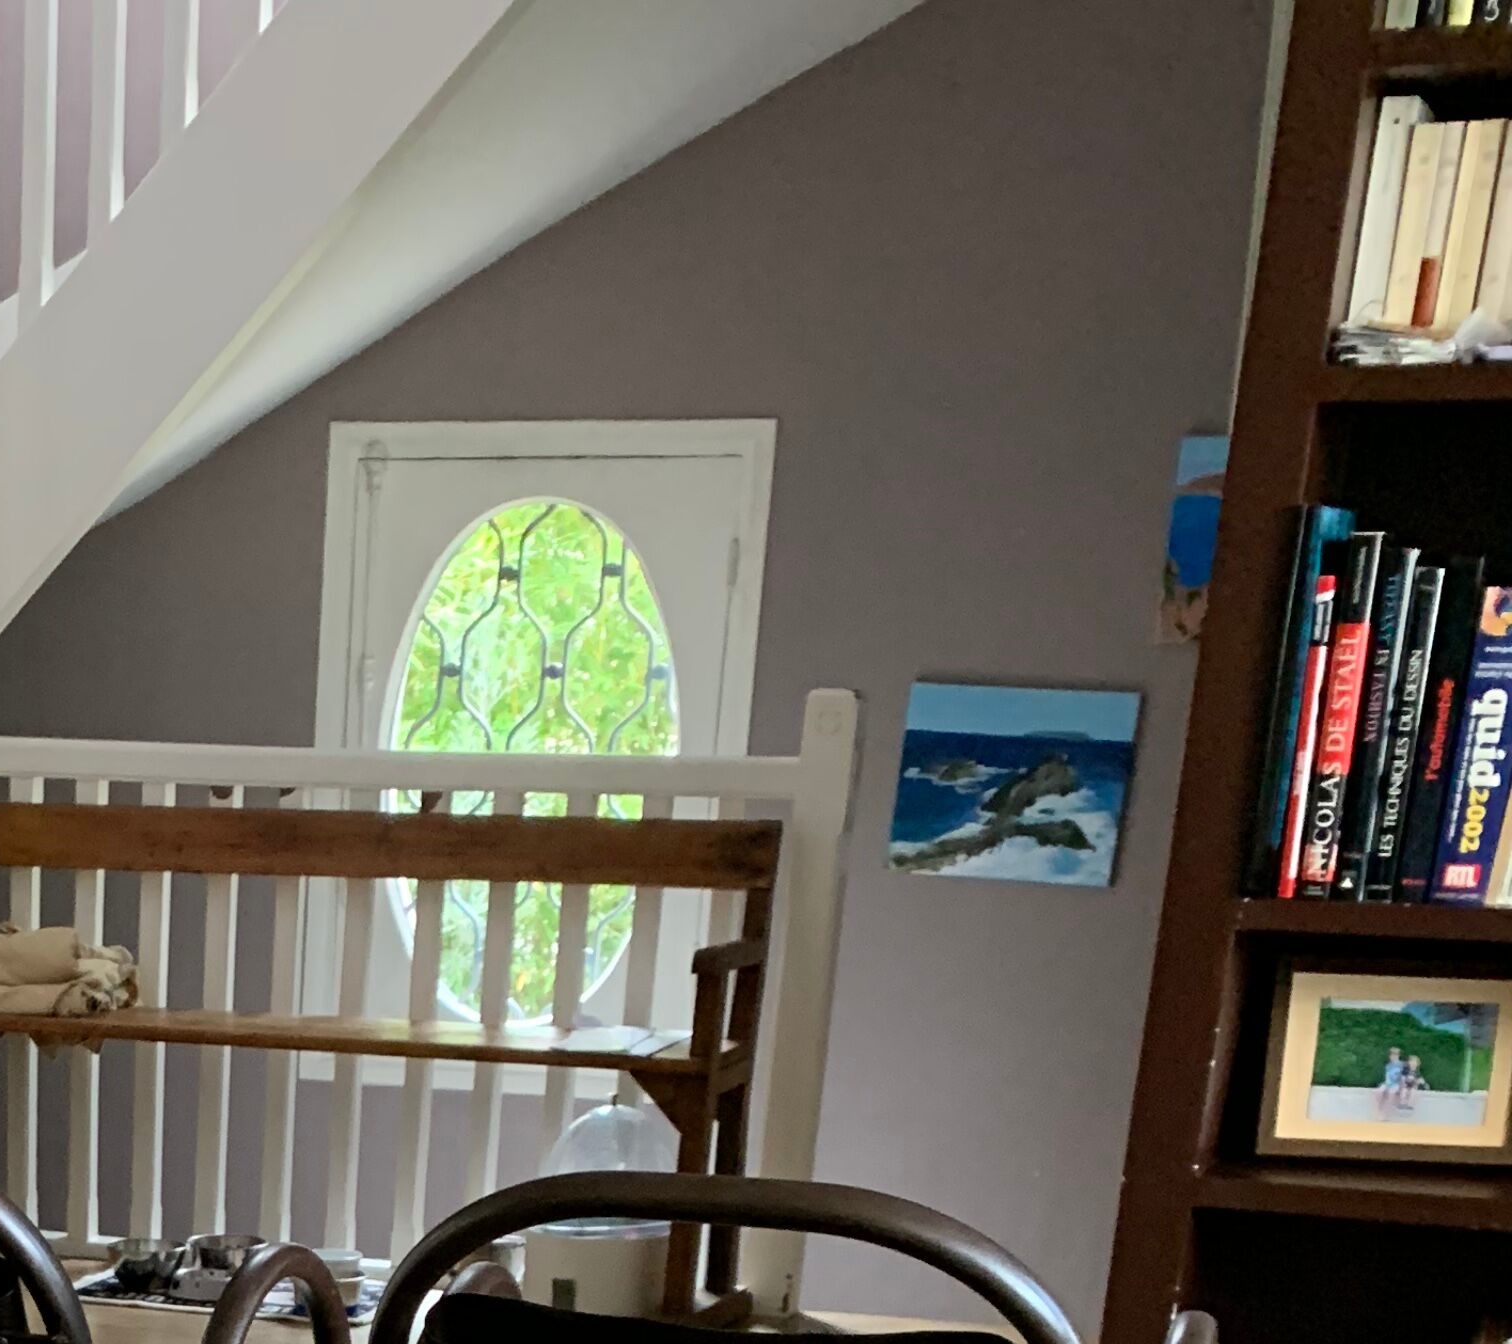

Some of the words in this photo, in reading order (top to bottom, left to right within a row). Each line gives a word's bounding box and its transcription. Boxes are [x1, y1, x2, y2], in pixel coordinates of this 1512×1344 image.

[1403, 650, 1423, 701] DESSIN
[1398, 706, 1415, 731] DU
[1306, 761, 1343, 879] NICOLAS
[1325, 718, 1349, 747] DE
[1383, 737, 1410, 828] TECHNIQUES
[1377, 833, 1395, 857] LES
[1443, 864, 1479, 888] RTL
